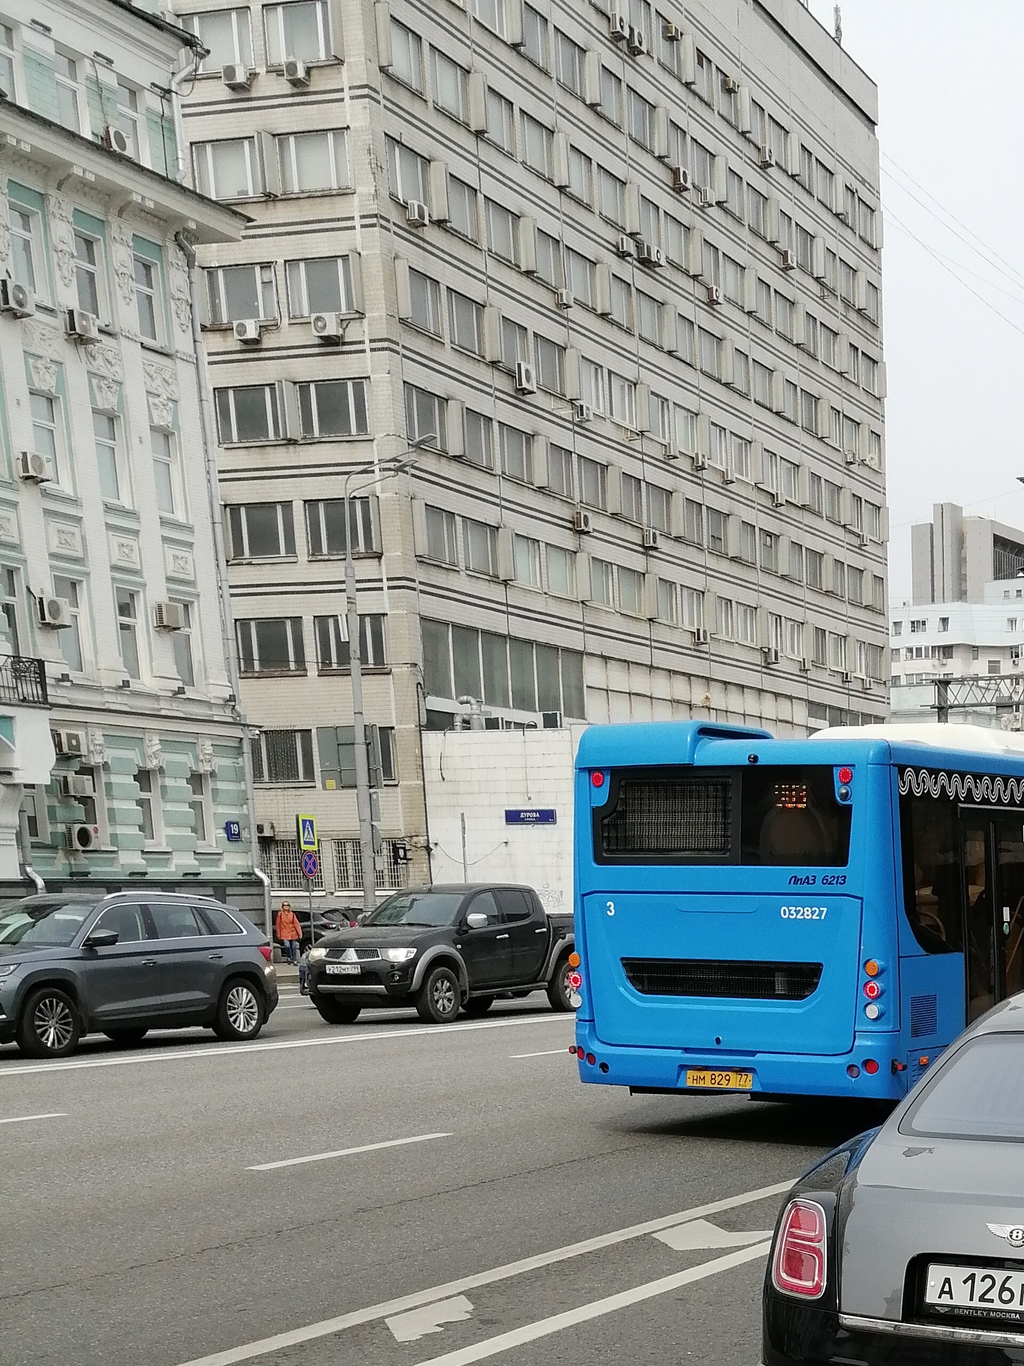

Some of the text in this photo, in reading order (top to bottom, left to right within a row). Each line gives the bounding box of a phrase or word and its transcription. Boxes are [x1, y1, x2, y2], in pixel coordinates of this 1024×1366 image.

[230, 823, 239, 834] 19
[821, 875, 847, 886] 6213
[606, 901, 615, 916] 3
[780, 906, 828, 920] 032827
[692, 1073, 749, 1086] НМ 829 77
[954, 1308, 988, 1317] BENTLEY
[989, 1311, 1020, 1320] МОСКВА
